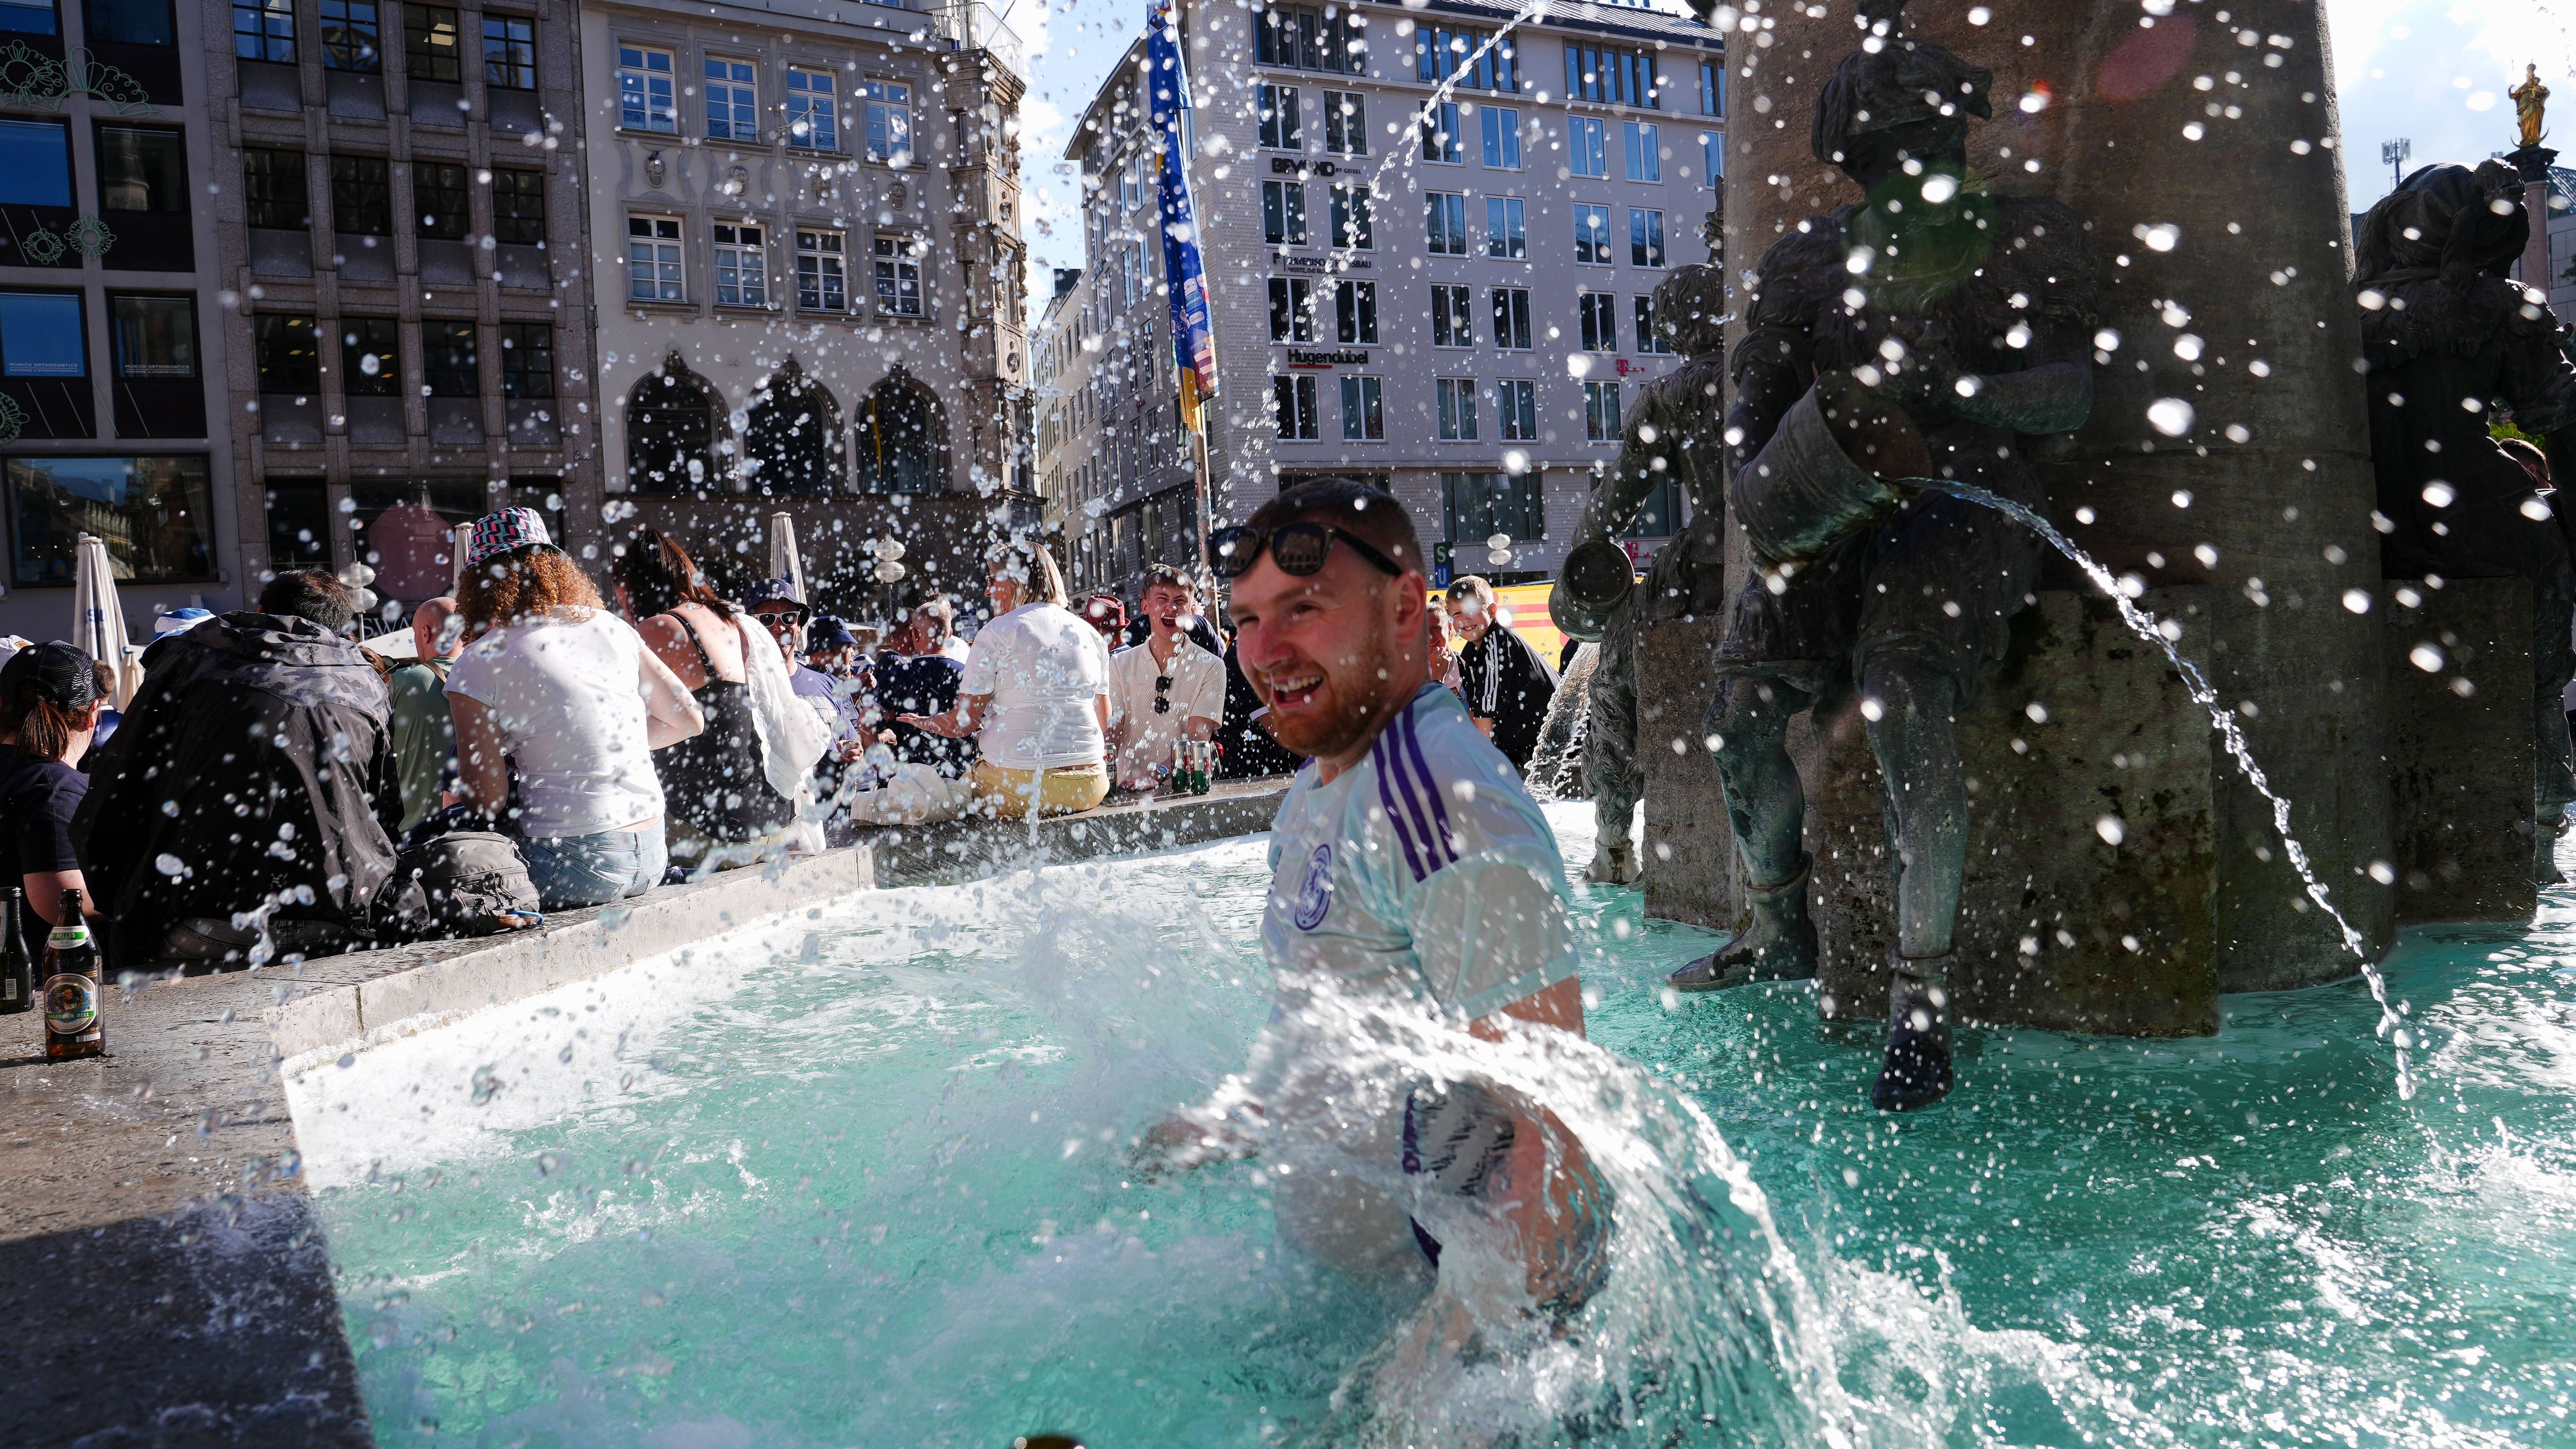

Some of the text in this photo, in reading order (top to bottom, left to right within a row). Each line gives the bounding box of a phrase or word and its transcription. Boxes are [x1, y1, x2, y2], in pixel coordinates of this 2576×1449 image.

[1287, 349, 1368, 365] Hugendubel
[1437, 546, 1446, 563] S
[1438, 568, 1447, 585] U
